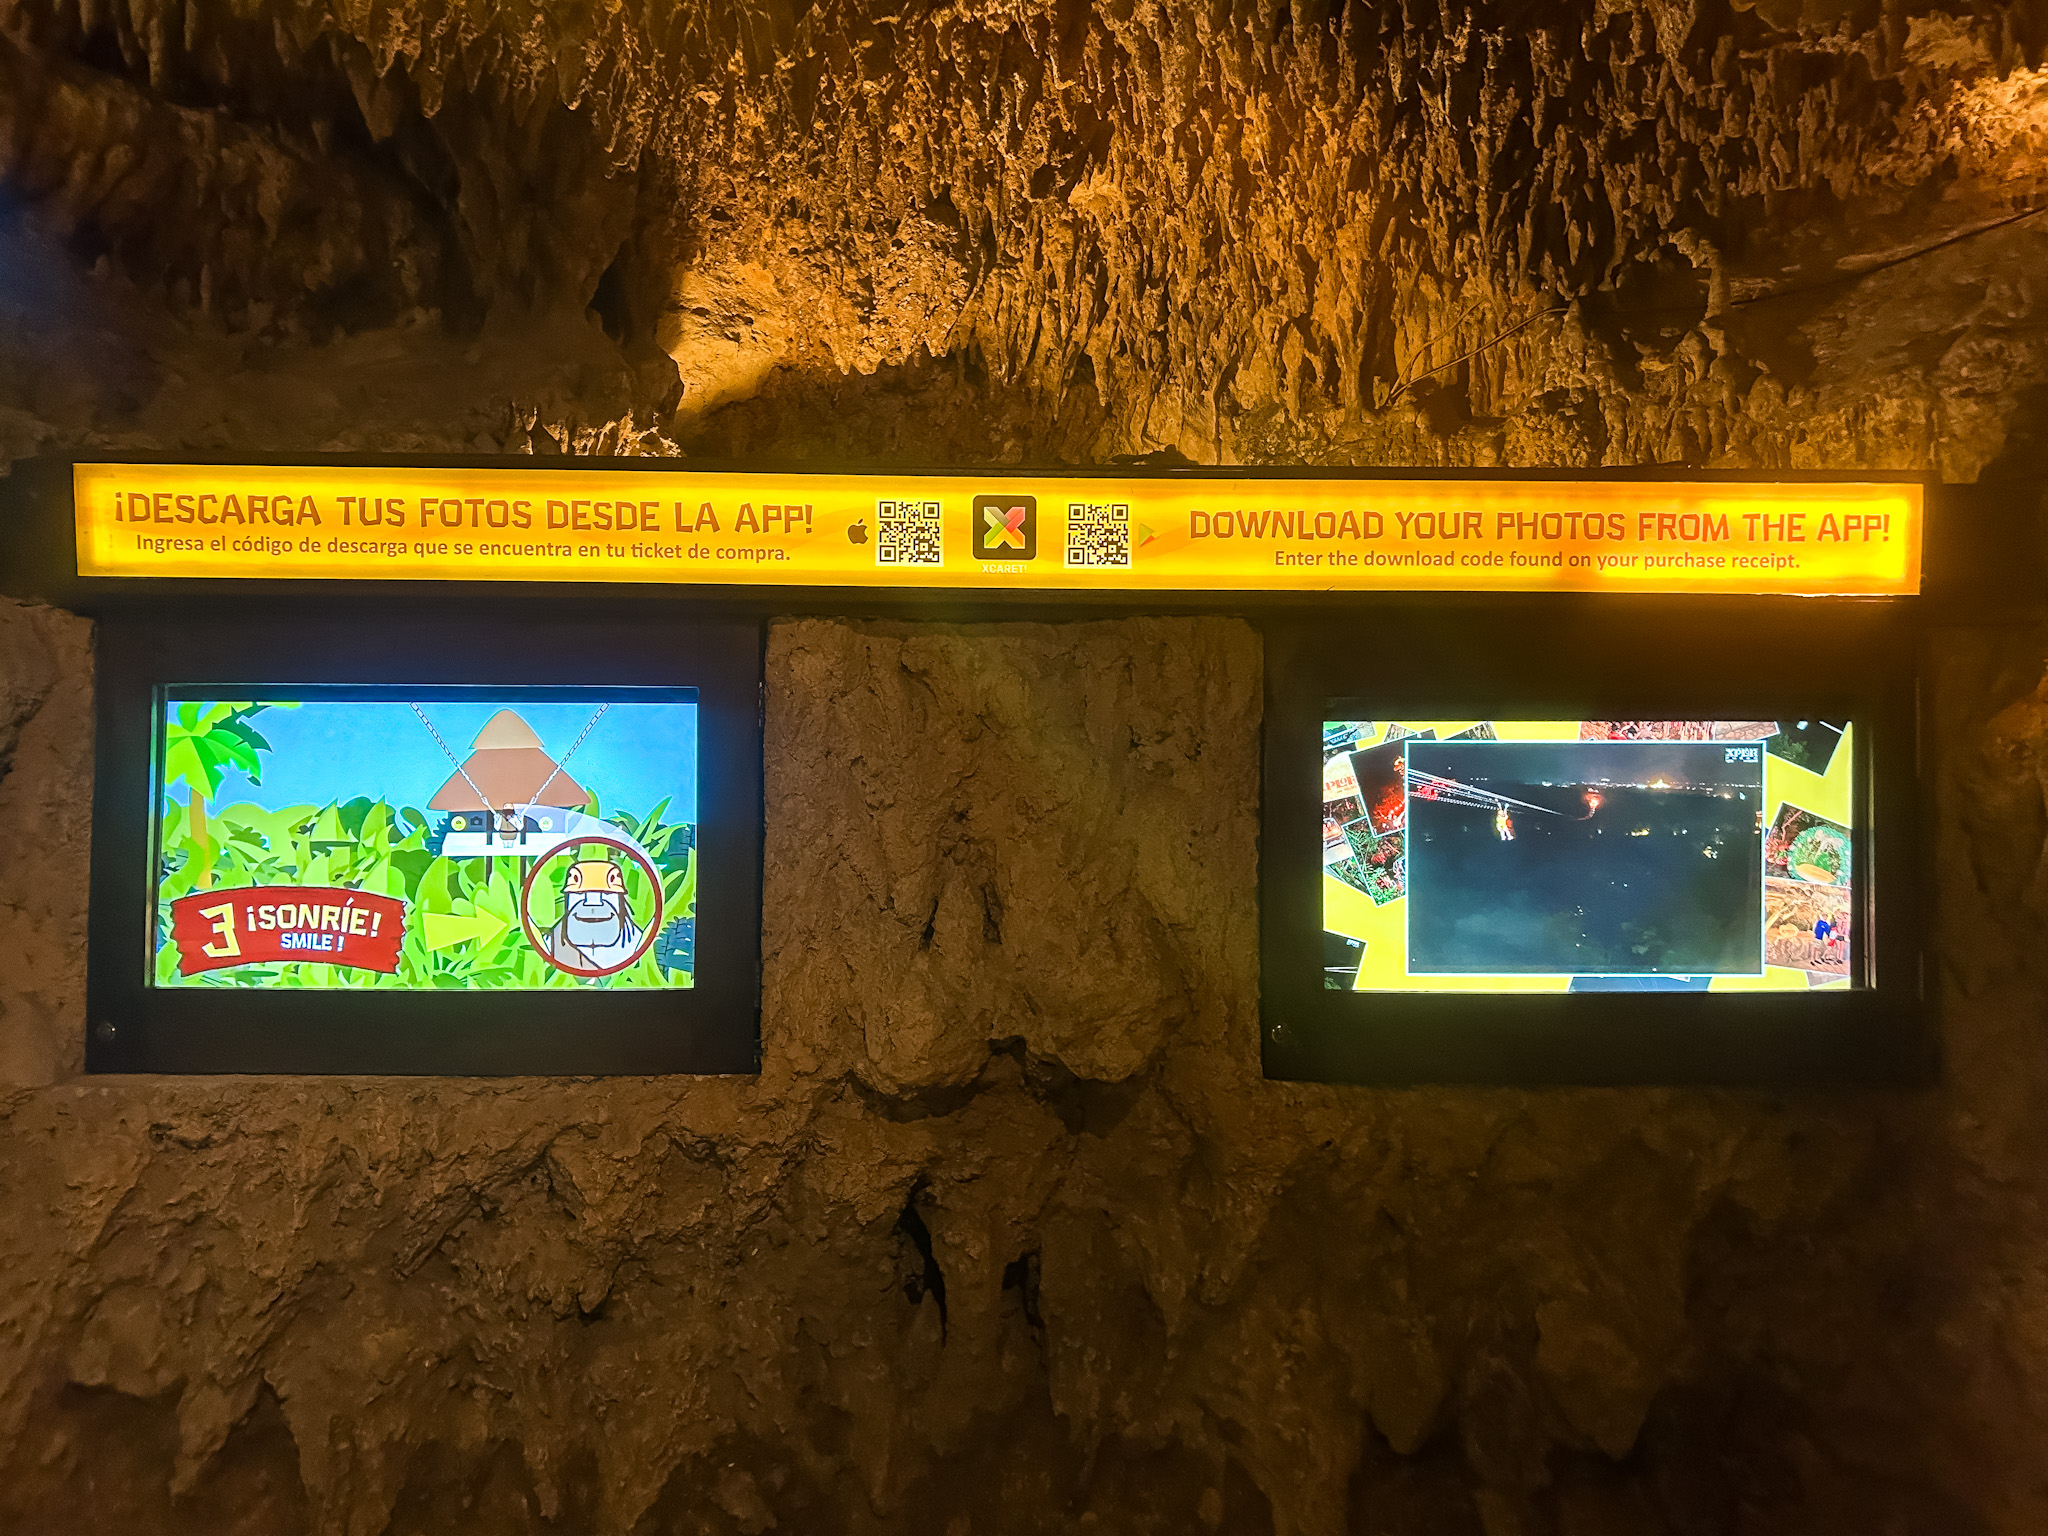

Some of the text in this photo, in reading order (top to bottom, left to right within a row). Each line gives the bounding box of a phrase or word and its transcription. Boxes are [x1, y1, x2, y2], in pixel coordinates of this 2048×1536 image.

[115, 491, 813, 535] ¡DESCARGA TUS FOTOS DESDE LA APP!
[1190, 509, 1890, 543] DOWNLOAD YOUR PHOTOS FROM THE APP!
[137, 534, 790, 564] Ingresa el código de descarga que se encuentra en tu ticket de compra.
[1275, 551, 1800, 572] Enter the download code found on your purchase receipt.
[981, 564, 1028, 574] XCARET!
[199, 902, 241, 958] 3
[246, 897, 382, 938] ¡SONRÍE!
